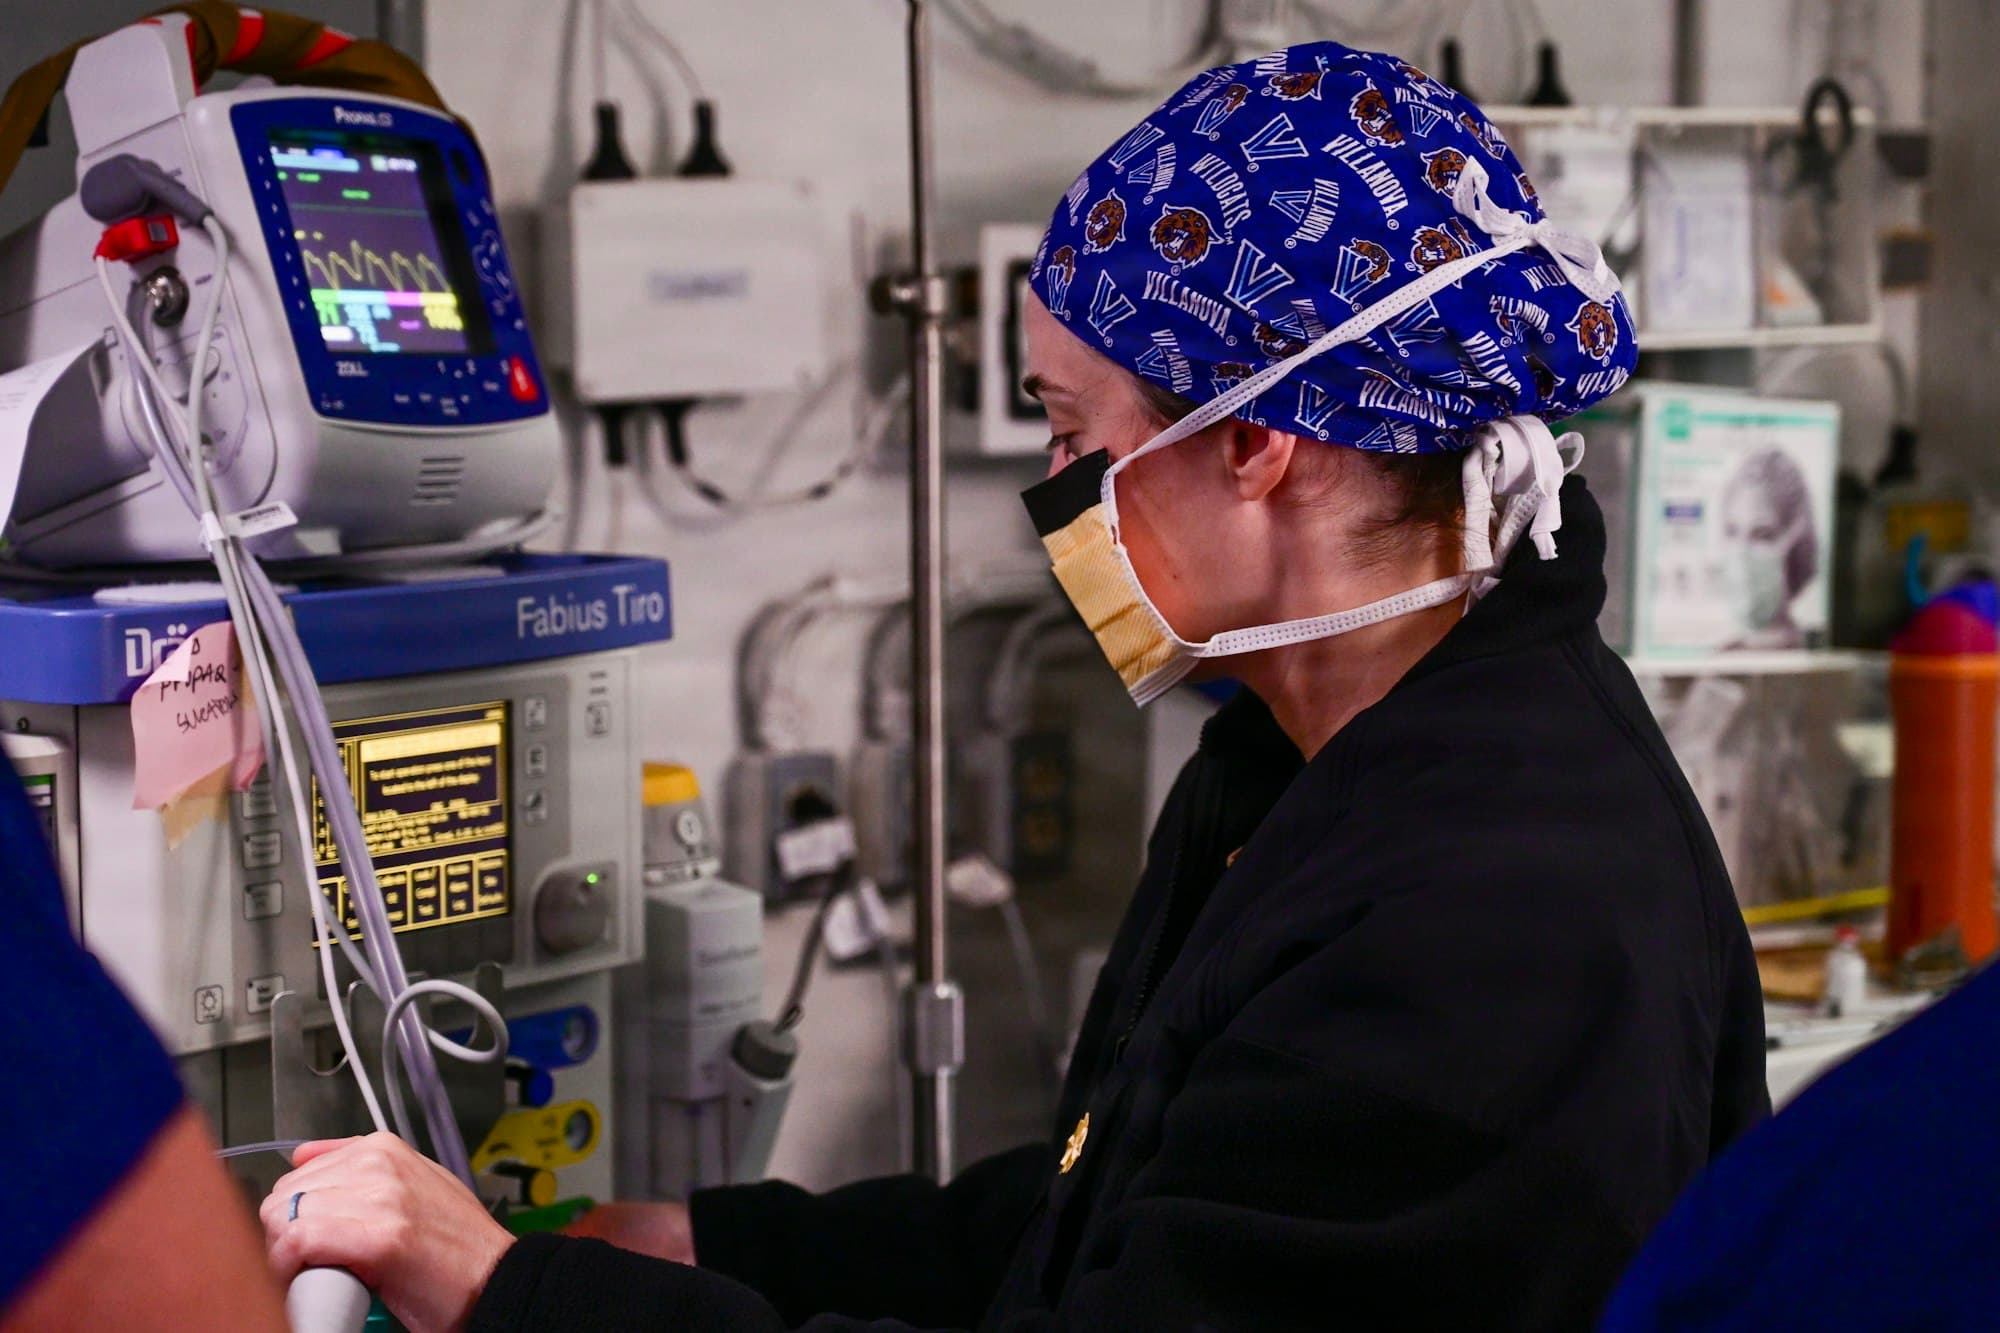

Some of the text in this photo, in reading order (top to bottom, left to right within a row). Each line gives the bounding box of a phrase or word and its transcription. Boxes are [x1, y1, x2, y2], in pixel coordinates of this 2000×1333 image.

[1149, 142, 1177, 194] VILLANOVA
[1240, 113, 1309, 161] V
[1188, 153, 1252, 229] WILDCATS
[1321, 133, 1409, 218] VILLANOVA
[1291, 177, 1340, 243] VILLANOVA
[1087, 269, 1137, 337] V
[1141, 270, 1232, 339] VILLANOVA
[1223, 238, 1295, 311] V
[1150, 328, 1193, 393] VILLANOVA
[1358, 380, 1448, 429] VILLANOVA
[516, 583, 665, 639] Fabius Tiro
